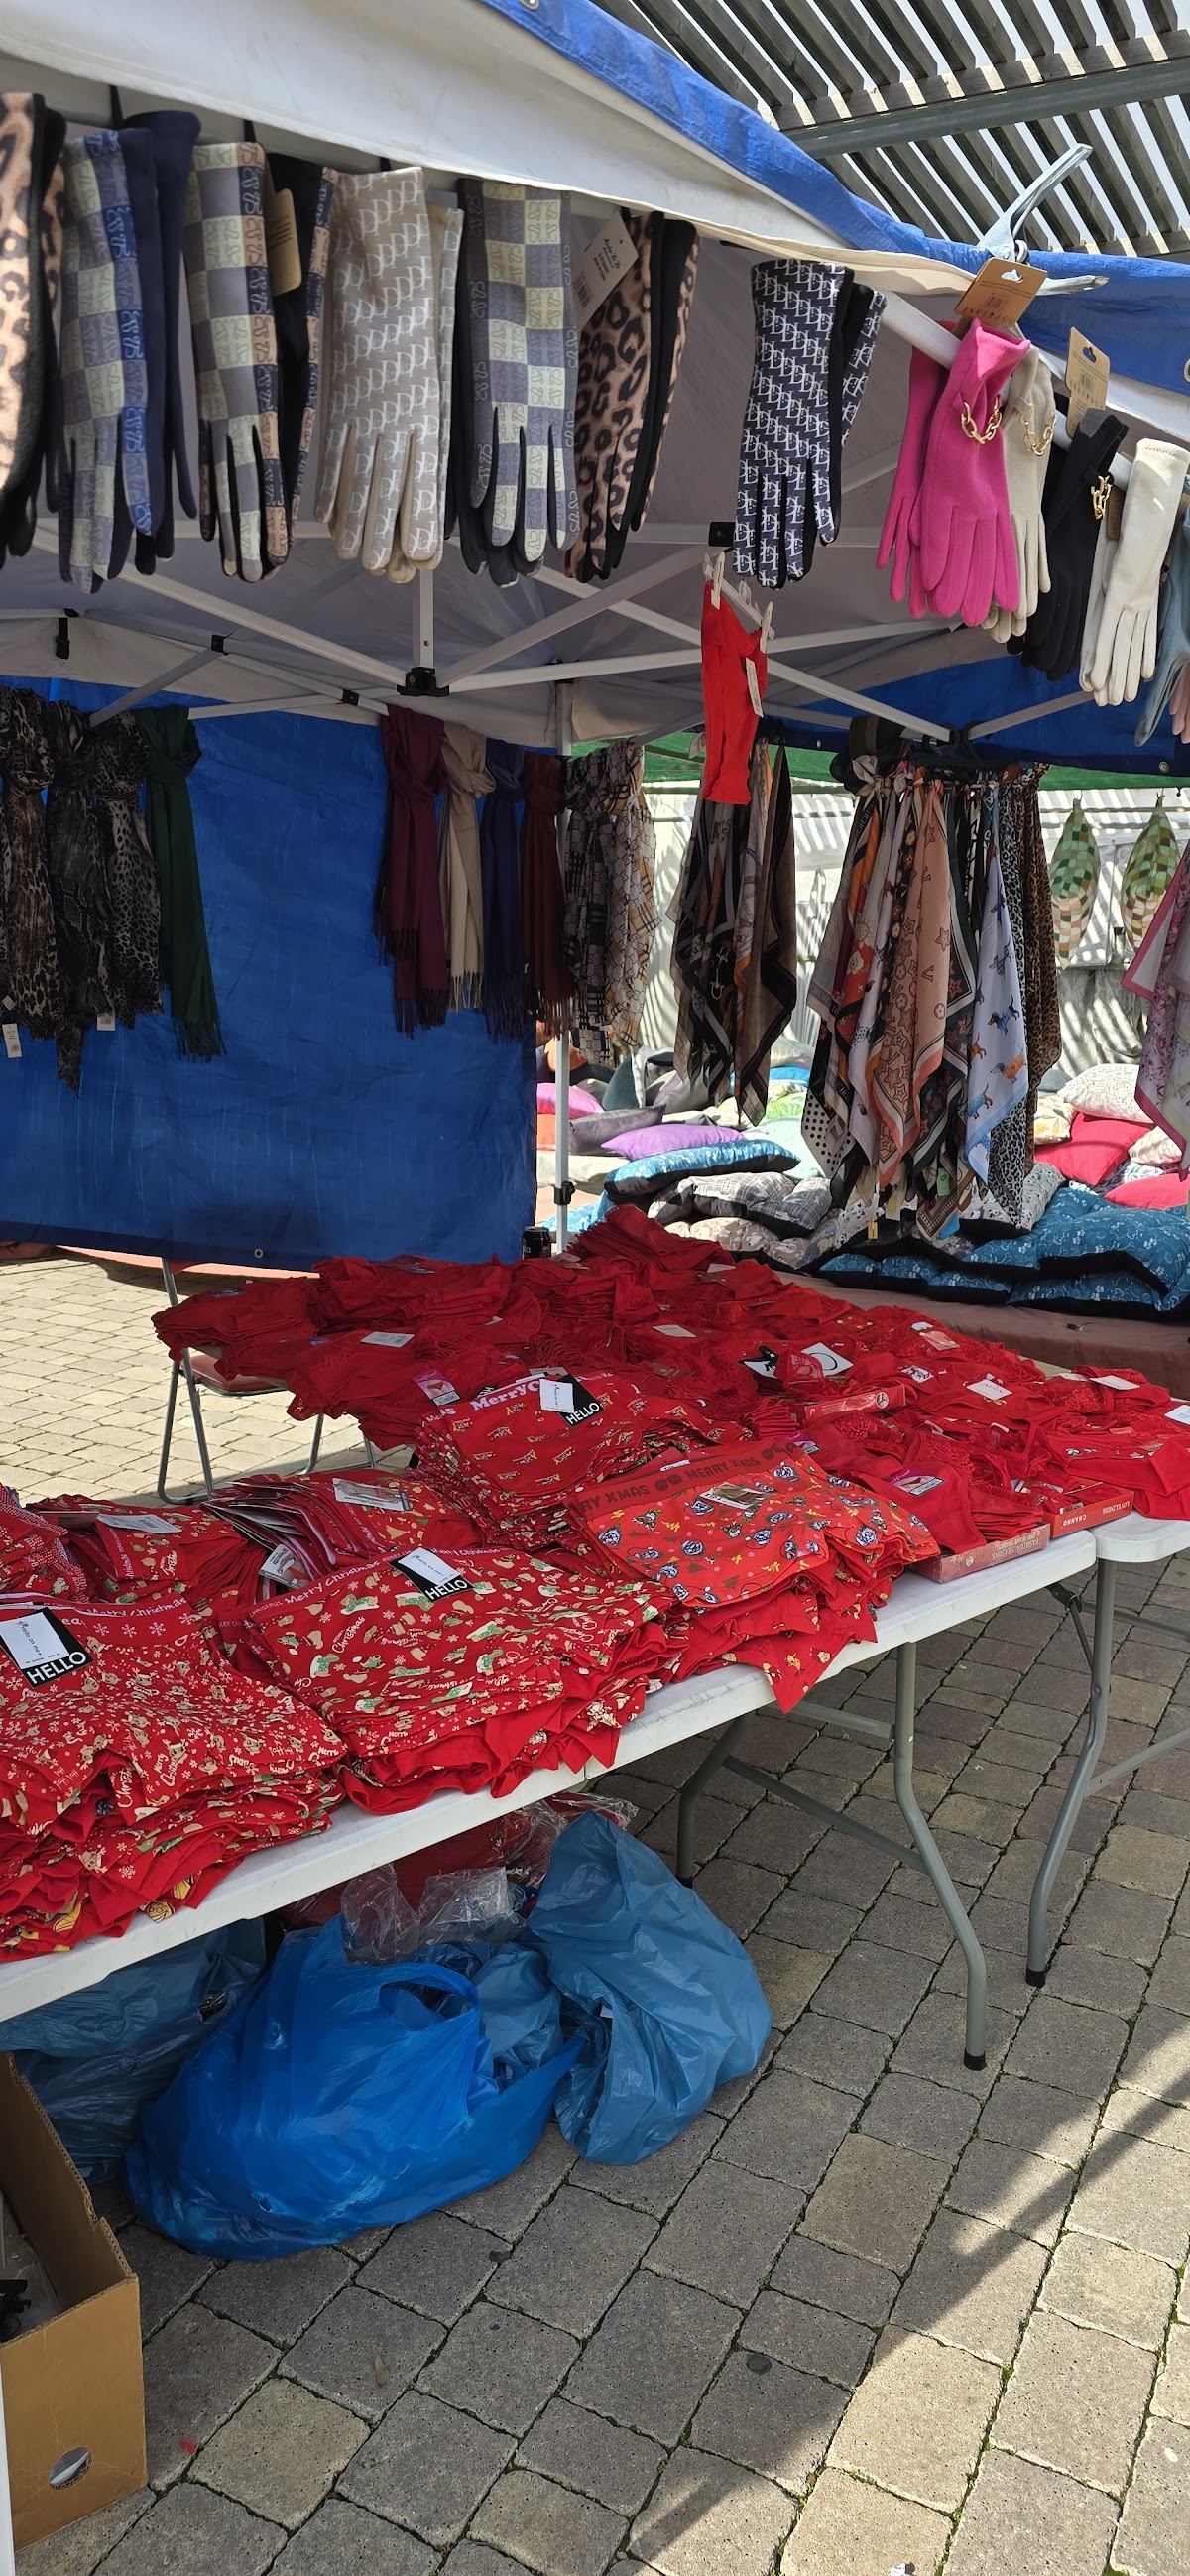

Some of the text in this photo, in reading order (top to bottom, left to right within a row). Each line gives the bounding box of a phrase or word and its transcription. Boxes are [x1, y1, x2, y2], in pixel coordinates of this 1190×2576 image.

[565, 1402, 600, 1425] HELLO
[686, 1461, 727, 1479] MERRY
[604, 1485, 650, 1504] XMAS
[285, 1583, 323, 1605] Merry
[325, 1560, 381, 1586] Christmas
[424, 1579, 468, 1600] HELLO
[331, 1615, 366, 1654] Christmas
[26, 1651, 87, 1685] HELLO
